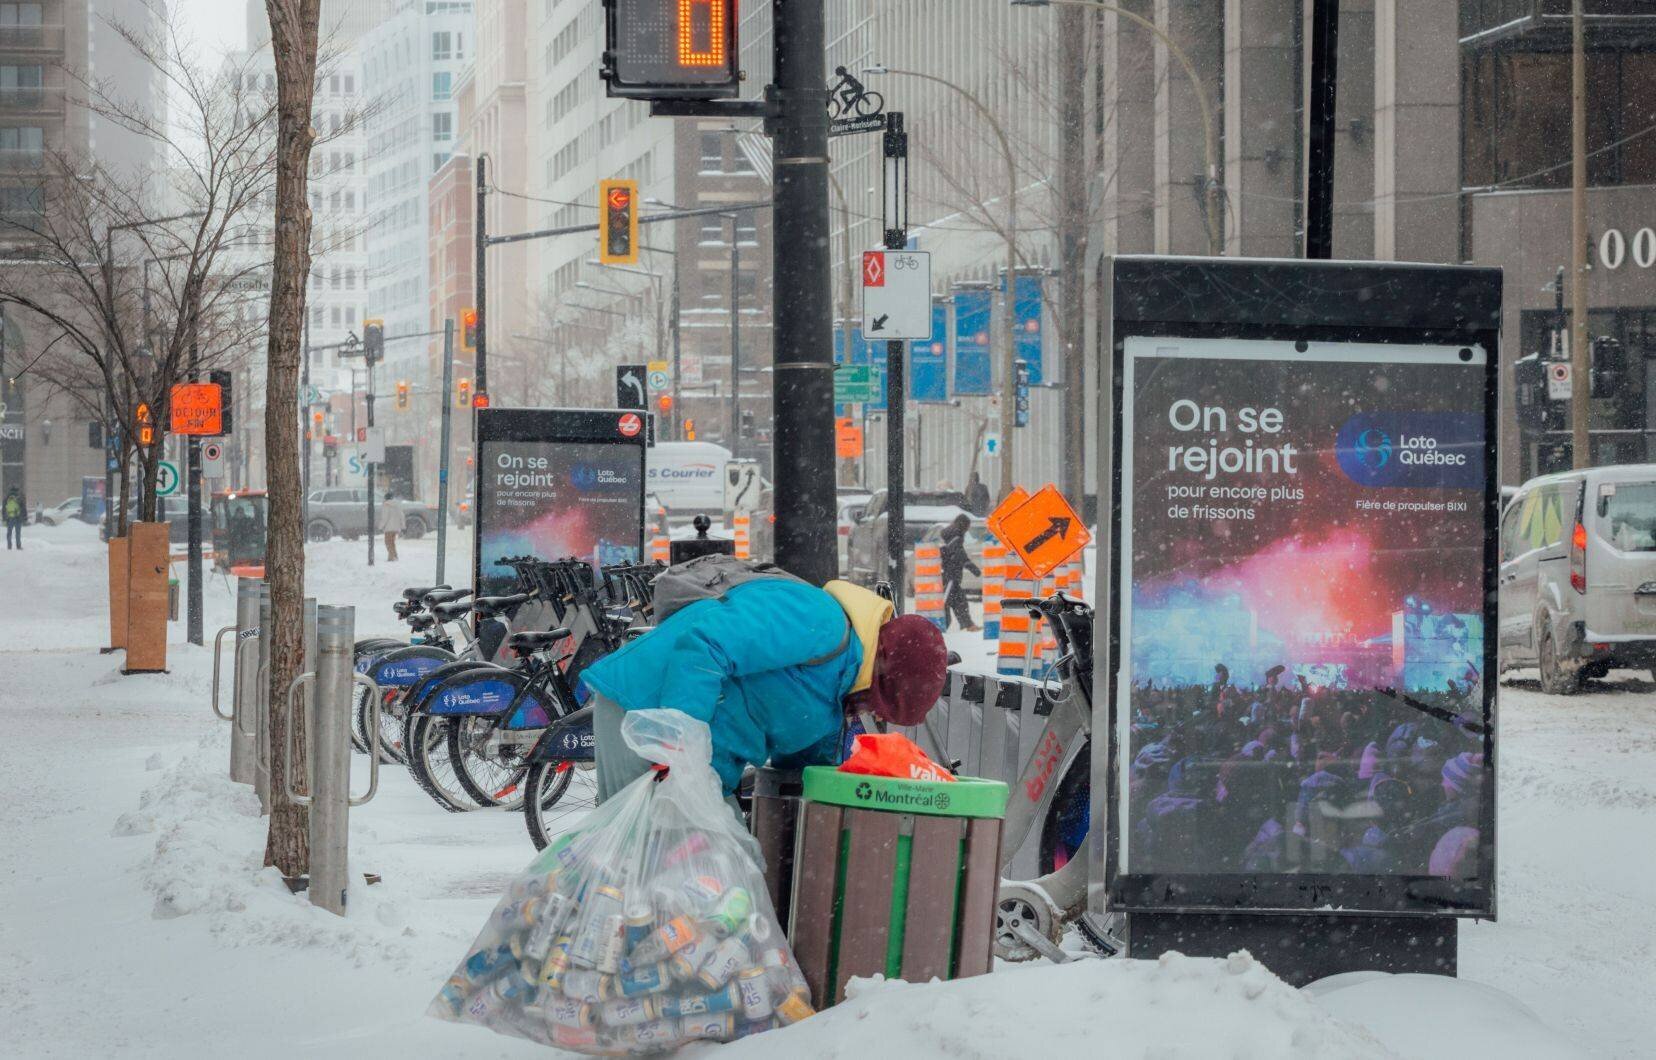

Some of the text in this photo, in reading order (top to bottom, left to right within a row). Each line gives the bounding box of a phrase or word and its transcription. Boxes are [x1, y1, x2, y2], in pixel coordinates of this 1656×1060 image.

[1585, 228, 1656, 270] 00
[1168, 399, 1284, 433] On se
[1400, 435, 1437, 449] Loto
[497, 453, 549, 469] On se
[1168, 438, 1298, 480] rejoint
[1400, 449, 1466, 466] Québec
[497, 471, 554, 489] rejoint
[661, 468, 716, 478] Courier
[496, 490, 557, 499] pour encore plus
[1168, 484, 1305, 501] pour encore plus
[496, 499, 536, 507] de frissons
[1356, 499, 1467, 513] Fière de propulser BIXI
[1168, 504, 1256, 520] de frissons
[897, 783, 935, 793] Ville-Marie
[875, 789, 933, 806] Montréal
